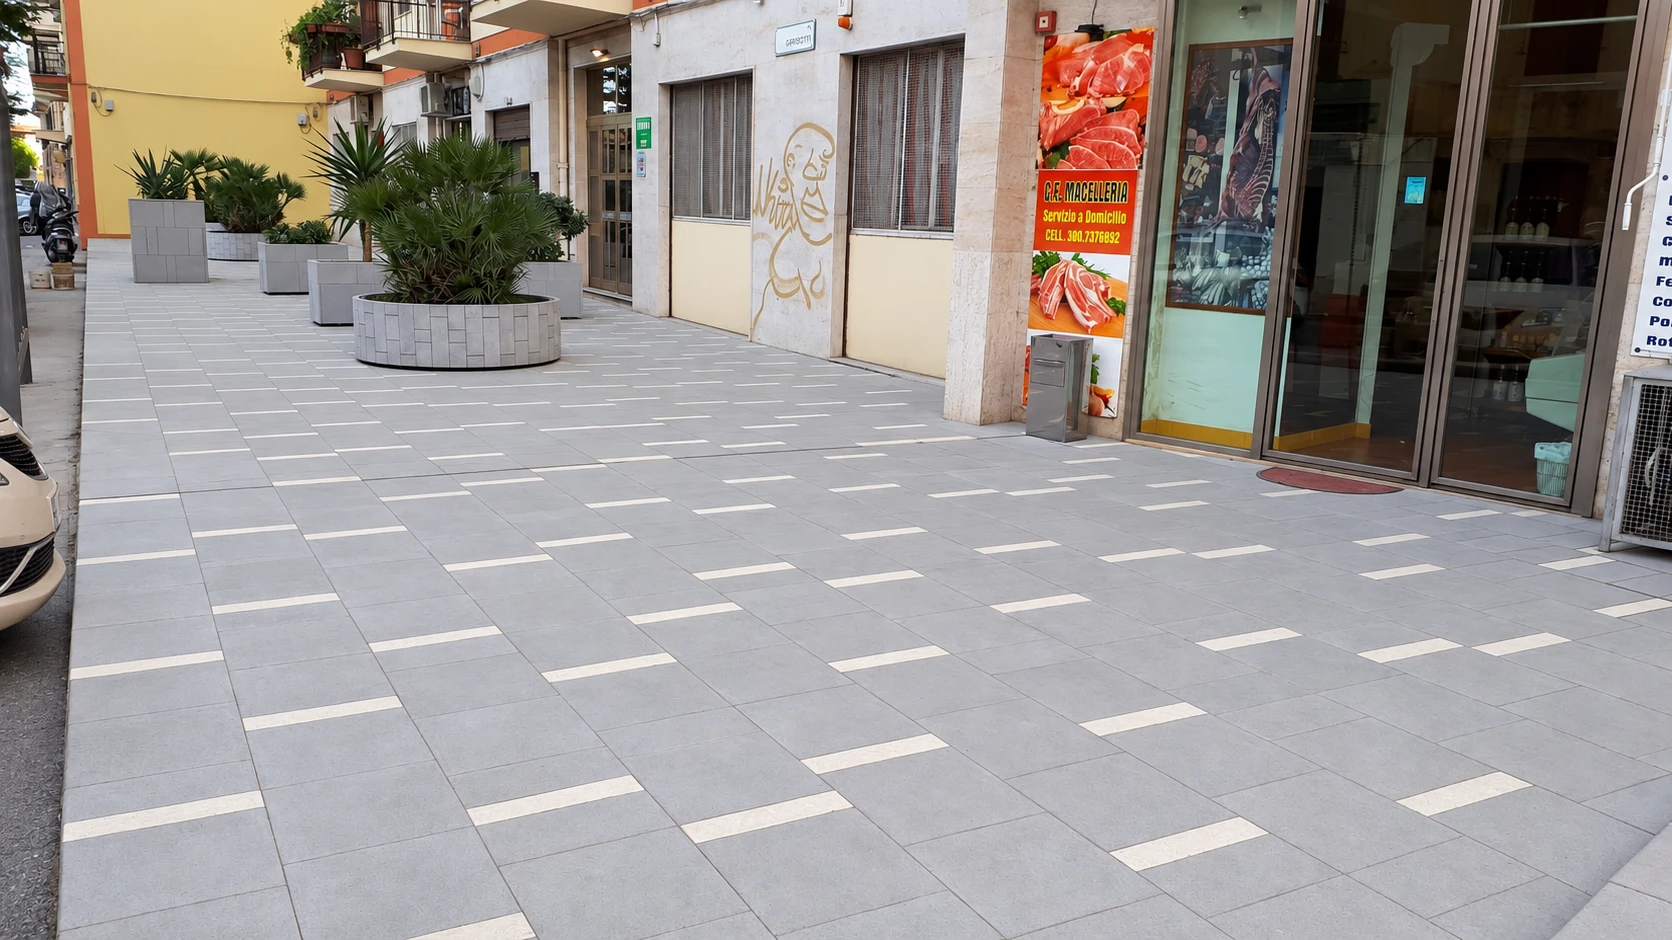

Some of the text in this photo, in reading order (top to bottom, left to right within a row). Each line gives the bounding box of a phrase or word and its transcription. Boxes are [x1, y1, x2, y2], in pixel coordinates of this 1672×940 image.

[1064, 181, 1128, 203] MACELLERIA
[1043, 209, 1127, 224] Servizio a Domicilio
[1045, 228, 1066, 242] CELL.
[1649, 315, 1672, 328] Po
